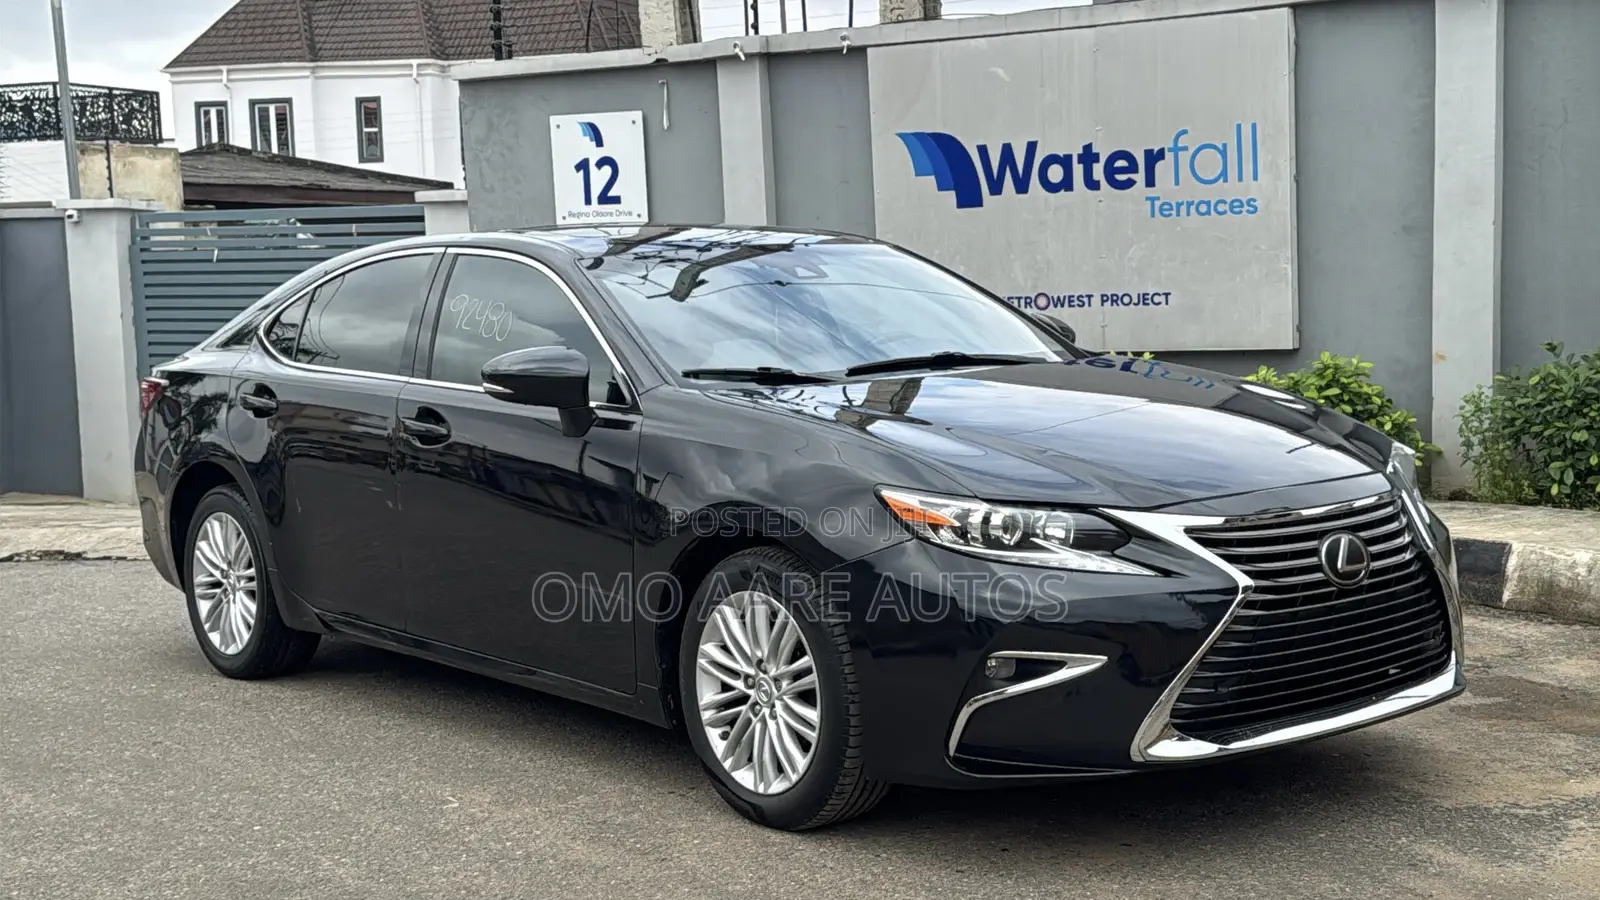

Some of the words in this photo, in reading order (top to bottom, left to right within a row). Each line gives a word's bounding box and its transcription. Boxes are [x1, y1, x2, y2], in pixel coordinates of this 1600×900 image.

[976, 122, 1259, 196] Waterfall
[574, 155, 622, 206] 12
[567, 210, 590, 219] Regina
[615, 209, 633, 217] Drive
[1145, 195, 1258, 218] Terraces
[450, 293, 513, 342] 92480
[1003, 292, 1094, 311] ETROWEST
[1100, 292, 1171, 307] PROJECT
